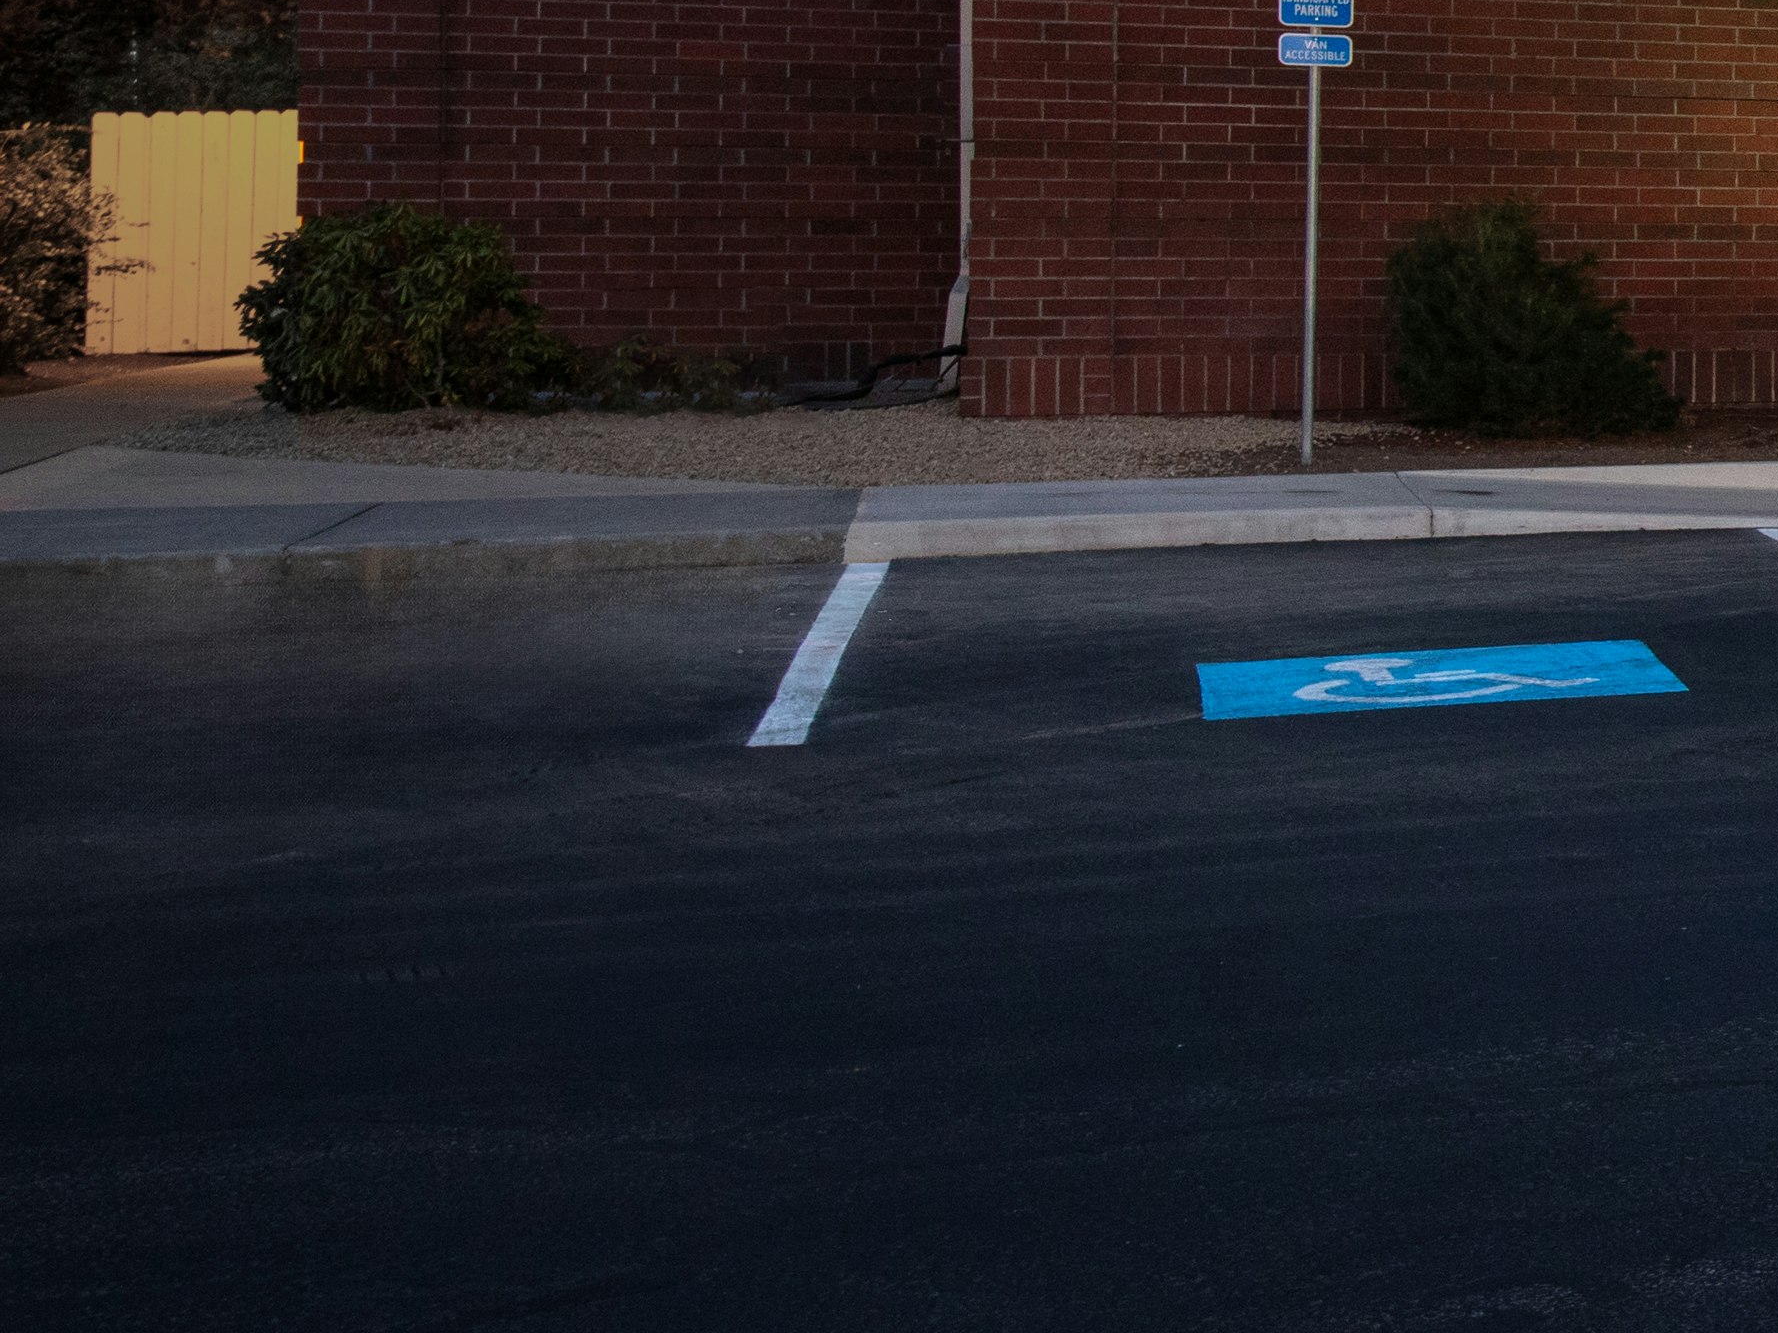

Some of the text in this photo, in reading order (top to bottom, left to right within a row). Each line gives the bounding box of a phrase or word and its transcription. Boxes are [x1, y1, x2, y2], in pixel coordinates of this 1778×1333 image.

[1294, 4, 1338, 17] PARKING
[1305, 40, 1327, 49] VAN
[1285, 50, 1346, 61] ACCESSIBLE
